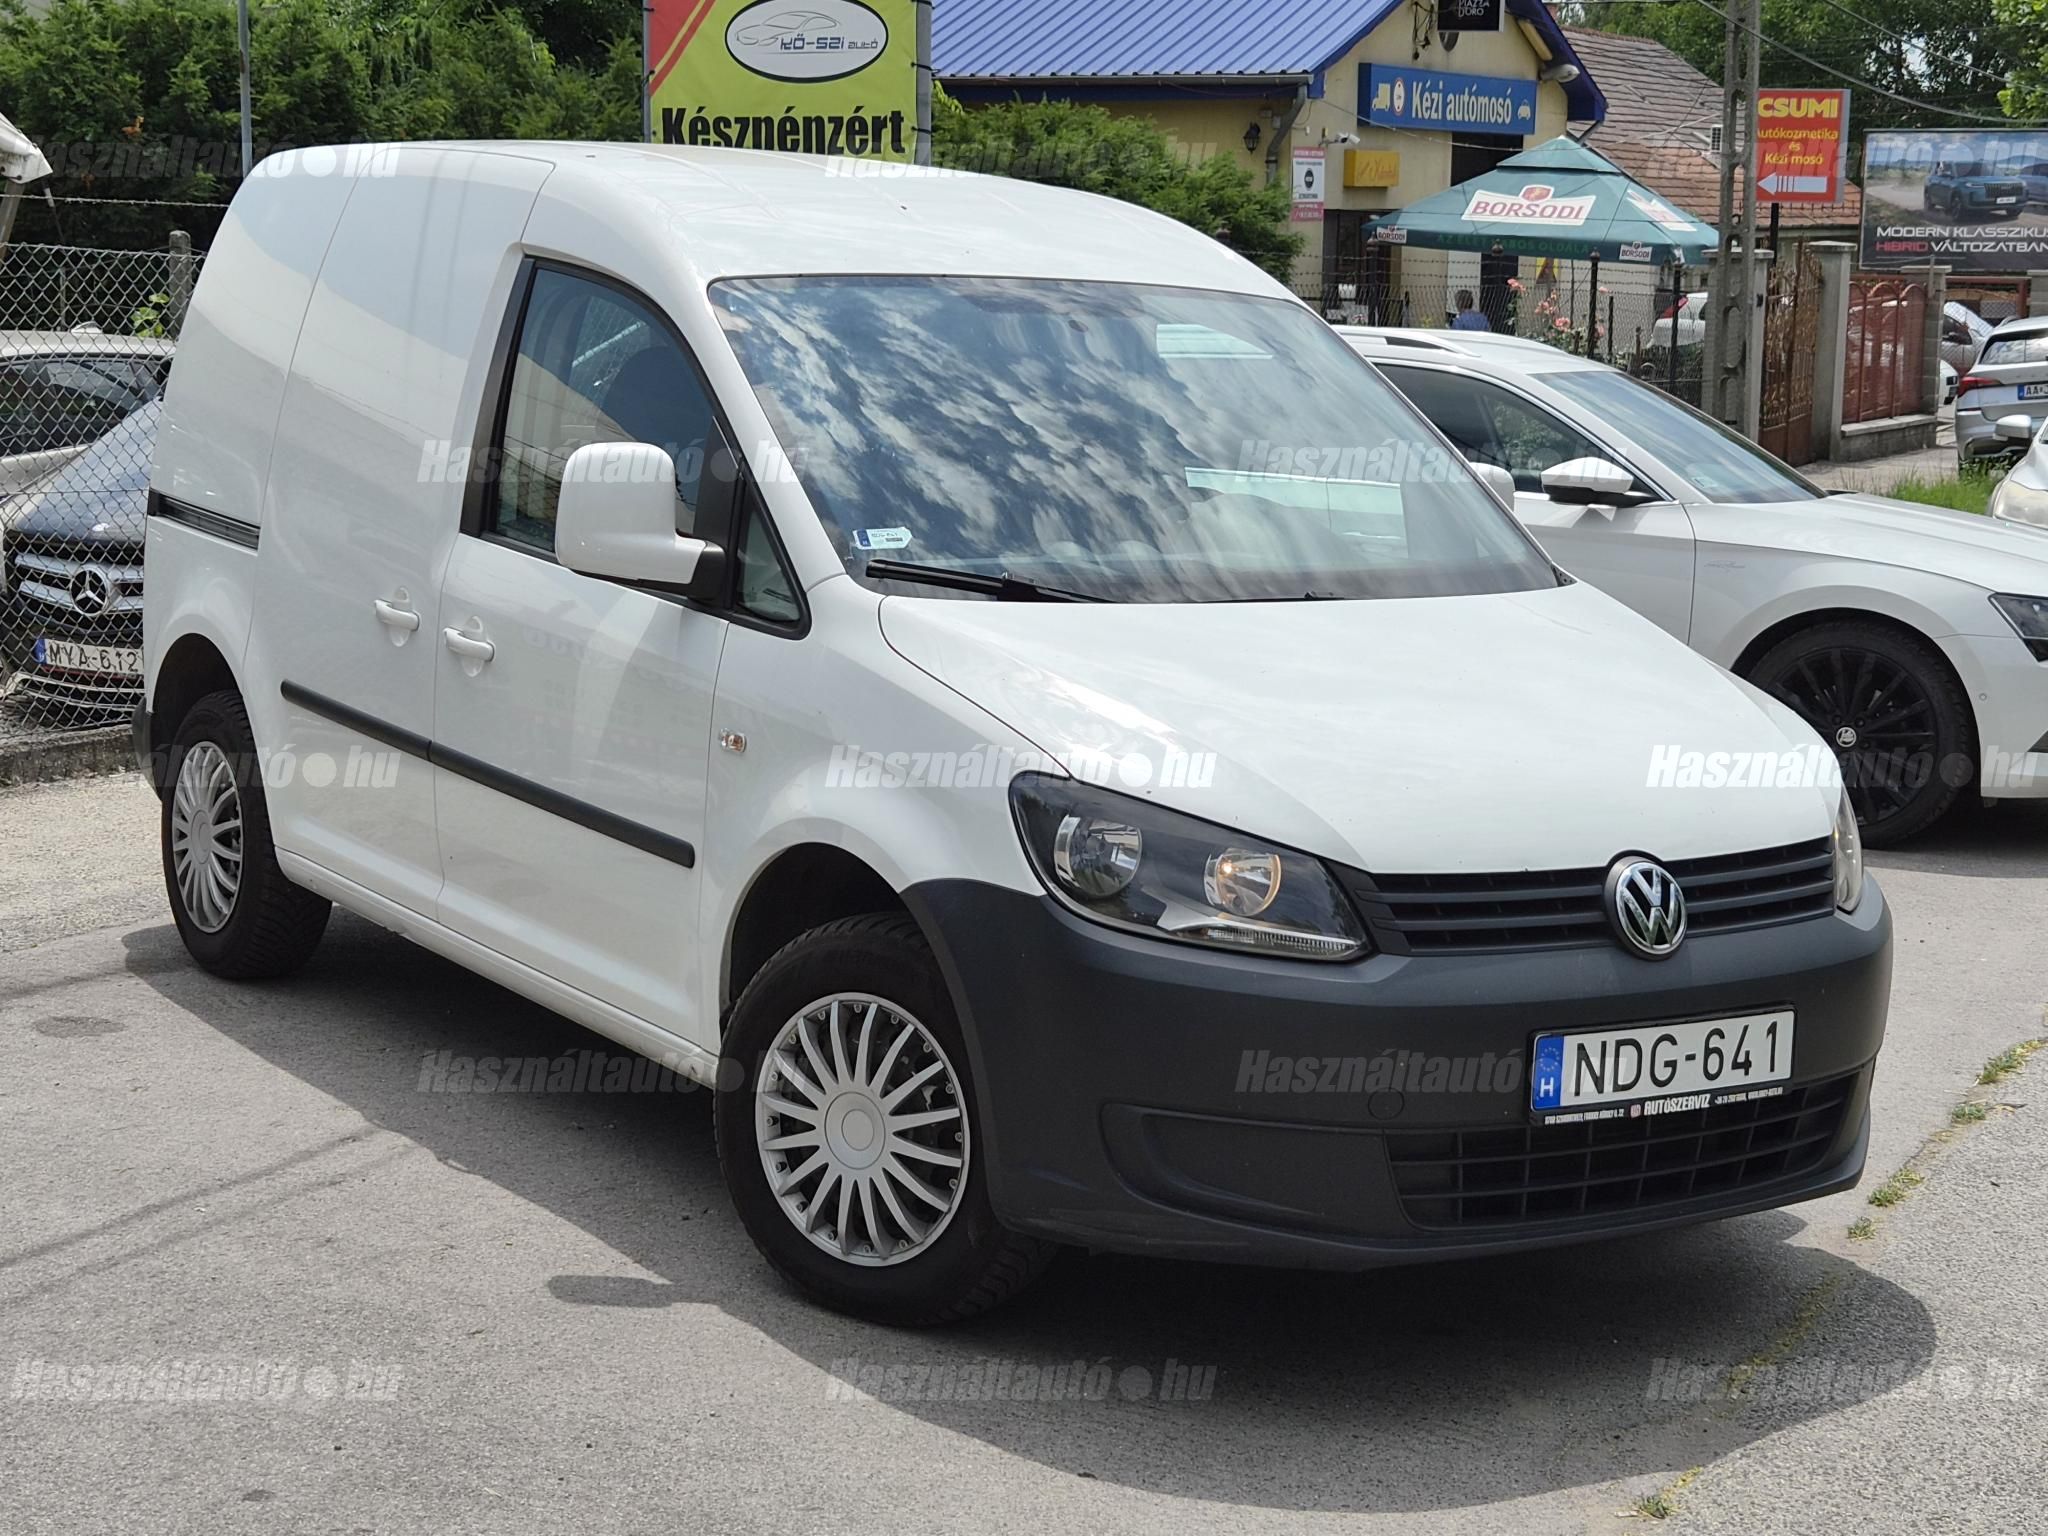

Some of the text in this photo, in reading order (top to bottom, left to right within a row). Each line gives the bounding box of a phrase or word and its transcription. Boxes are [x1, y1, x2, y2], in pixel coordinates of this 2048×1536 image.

[1412, 79, 1513, 125] Kézi autómosó
[1758, 97, 1839, 118] CSUMI
[1765, 152, 1823, 164] Kézi mosó
[1471, 200, 1584, 219] BORSODI
[1876, 227, 1949, 237] MODERN
[1876, 241, 1928, 252] HIBRID
[1573, 1020, 1778, 1097] NDG-641
[1643, 1093, 1711, 1116] AUTÓSZERVIZ
